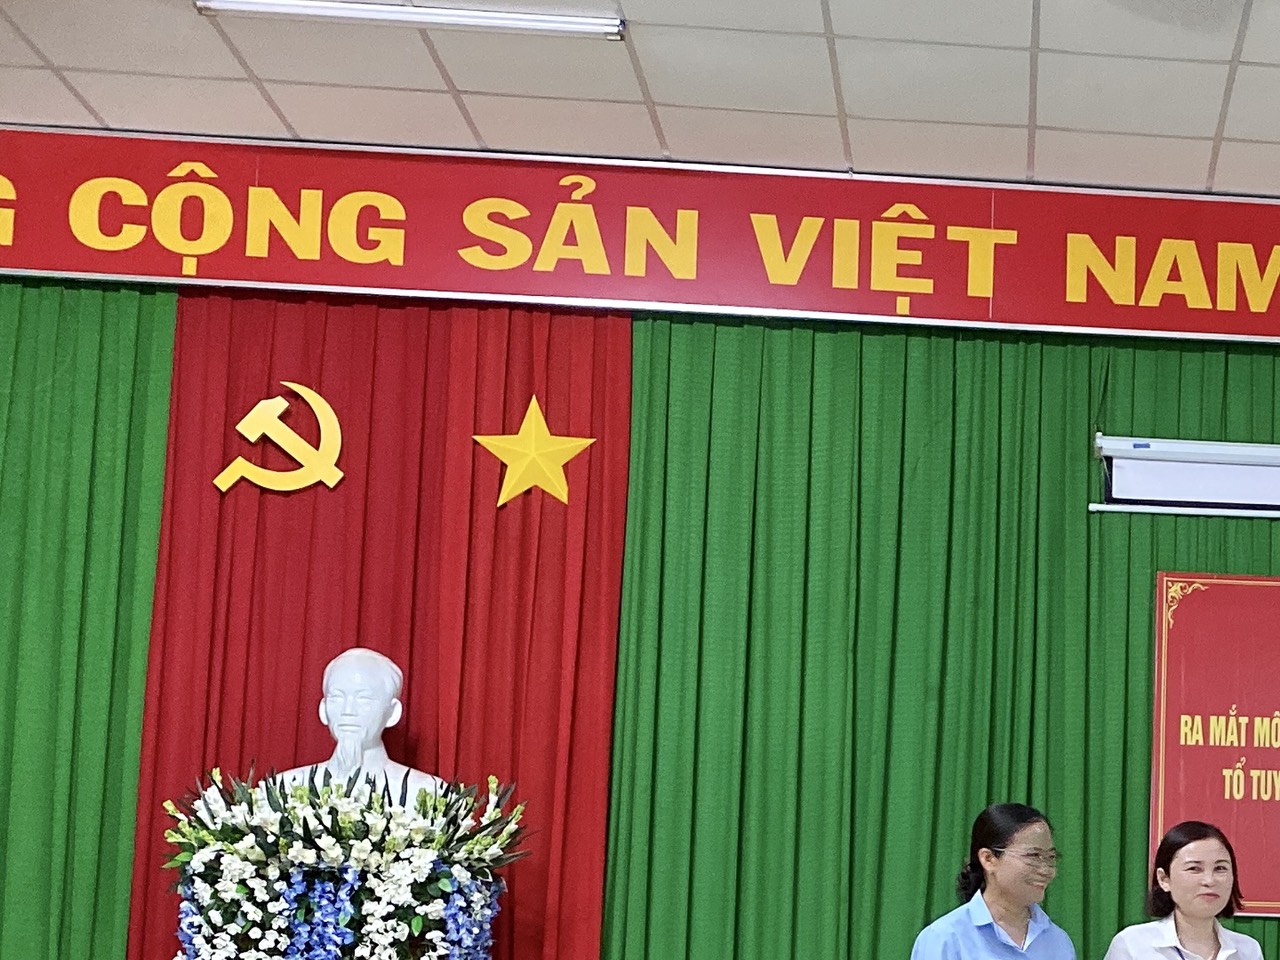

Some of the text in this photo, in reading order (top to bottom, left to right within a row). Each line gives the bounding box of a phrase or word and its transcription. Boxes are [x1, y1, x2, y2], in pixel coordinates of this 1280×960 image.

[68, 162, 406, 275] CỘNG
[458, 175, 698, 280] SẢN
[750, 204, 1017, 316] VIỆT
[1180, 715, 1203, 745] RA
[1210, 705, 1248, 746] MẮT
[1223, 757, 1245, 800] TỔ
